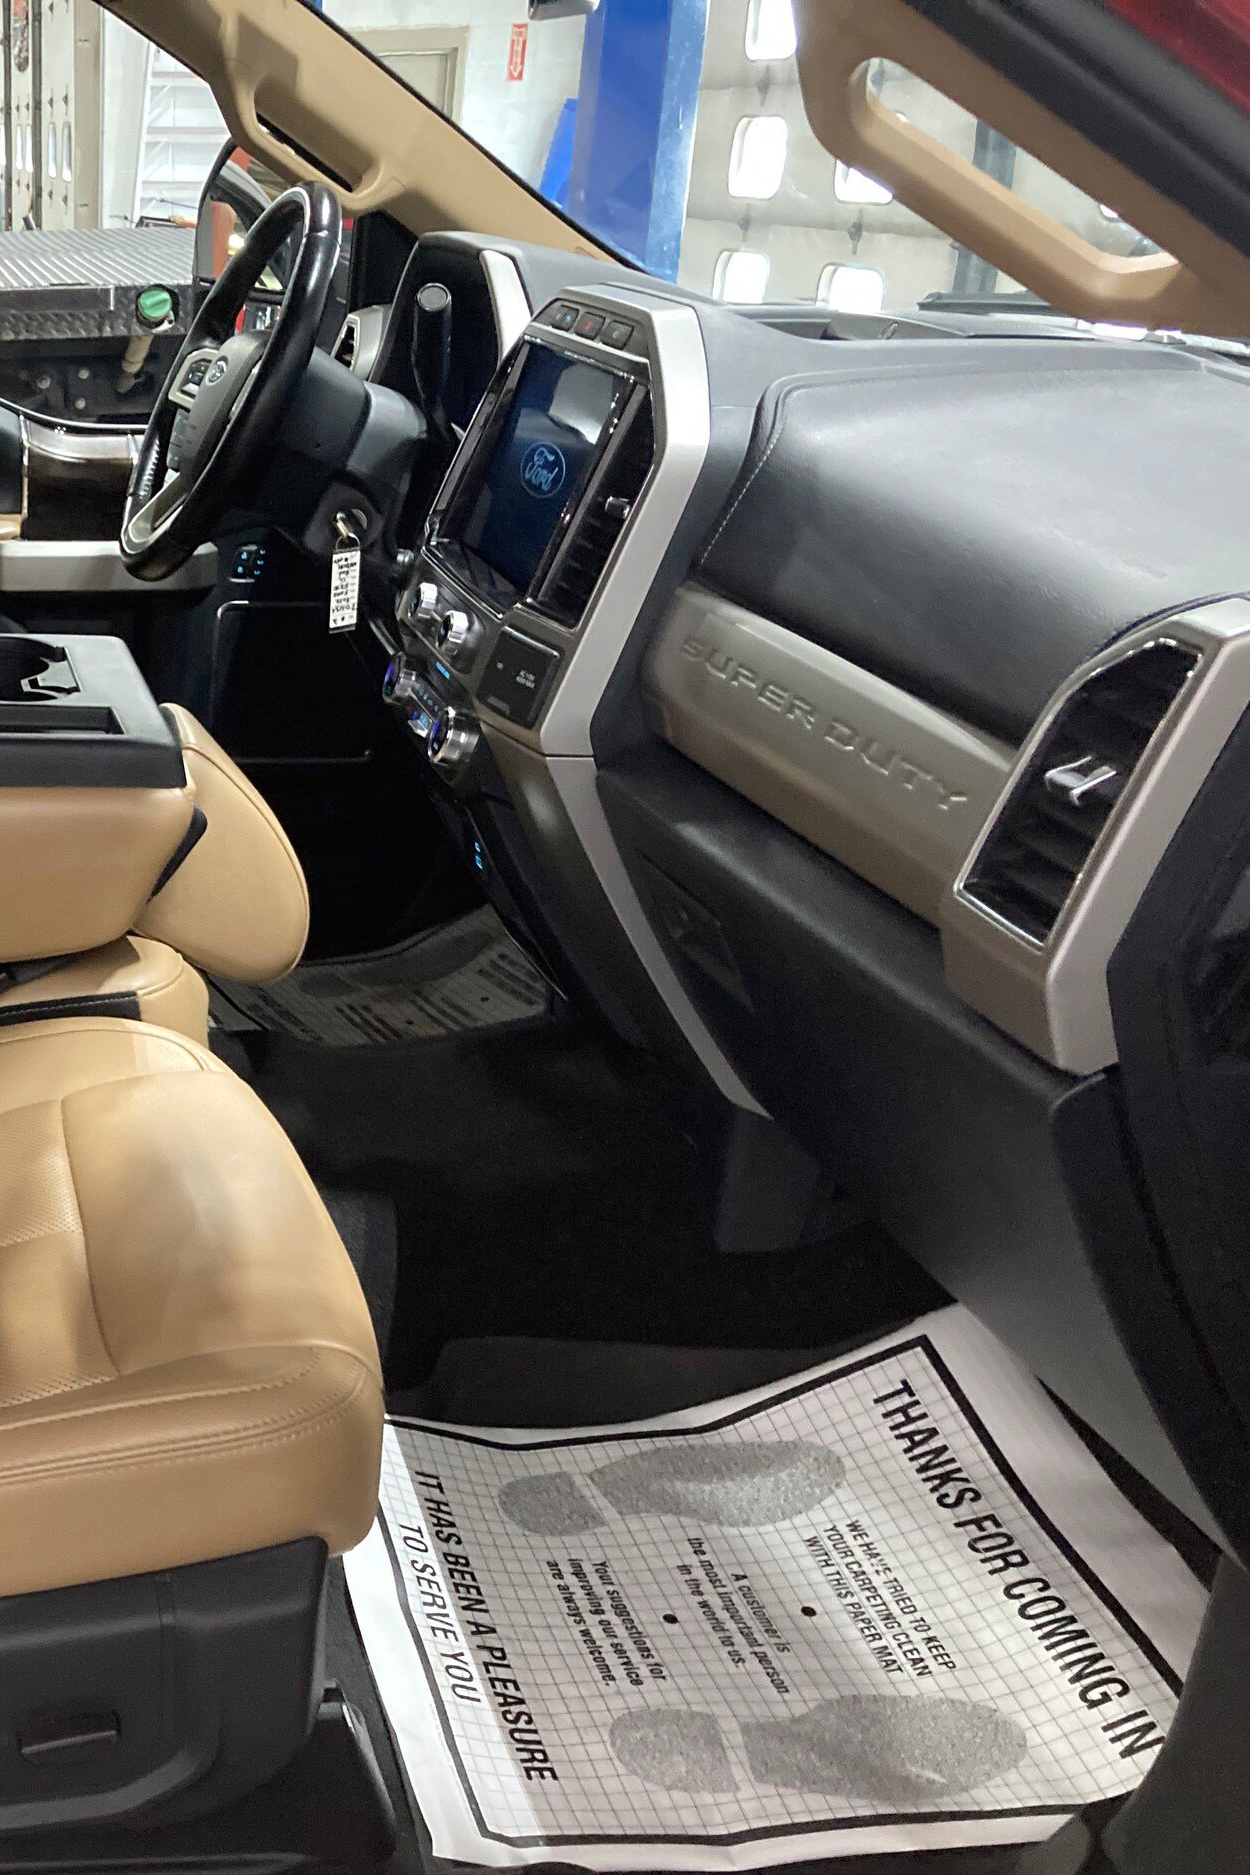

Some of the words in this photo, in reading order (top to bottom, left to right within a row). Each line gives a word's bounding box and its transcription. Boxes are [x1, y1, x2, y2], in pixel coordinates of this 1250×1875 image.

[525, 447, 559, 491] Ford
[682, 636, 816, 730] SUPER
[824, 719, 968, 811] DUTY
[414, 1471, 445, 1494] IT
[399, 1523, 429, 1553] TO
[424, 1498, 462, 1546] HAS
[410, 1559, 460, 1642] SERVE
[442, 1551, 489, 1614] BEEN
[546, 1560, 564, 1580] are
[557, 1584, 587, 1625] always
[731, 1573, 748, 1582] A
[823, 1524, 851, 1560] YOUR
[845, 1560, 901, 1630] CARPETING
[892, 1631, 933, 1677] CLEAN
[846, 1519, 869, 1542] WE
[859, 1541, 893, 1577] HAVE
[882, 1576, 918, 1615] TRIED
[909, 1616, 931, 1633] TO
[921, 1635, 957, 1670] KEEP
[873, 1379, 982, 1509] THANKS
[953, 1513, 1030, 1577] FOR
[1003, 1577, 1130, 1710] COMING
[1101, 1709, 1166, 1759] IN
[467, 1619, 497, 1637] A
[592, 1560, 616, 1586] Your
[606, 1589, 655, 1660] suggestions
[647, 1662, 667, 1681] for
[676, 1564, 692, 1576] in
[685, 1578, 704, 1597] the
[697, 1600, 729, 1633] world
[719, 1635, 735, 1648] to
[688, 1537, 706, 1556] the
[699, 1560, 727, 1589] most
[717, 1591, 764, 1647] important
[750, 1651, 790, 1694] person
[738, 1584, 782, 1639] customer
[804, 1536, 836, 1568] WITH
[825, 1569, 854, 1600] THIS
[844, 1602, 882, 1643] PAPER
[873, 1645, 903, 1674] MAT
[440, 1651, 482, 1703] YOU
[598, 1619, 618, 1639] our
[610, 1642, 644, 1686] service
[774, 1641, 791, 1653] is
[476, 1644, 560, 1782] PLEASURE
